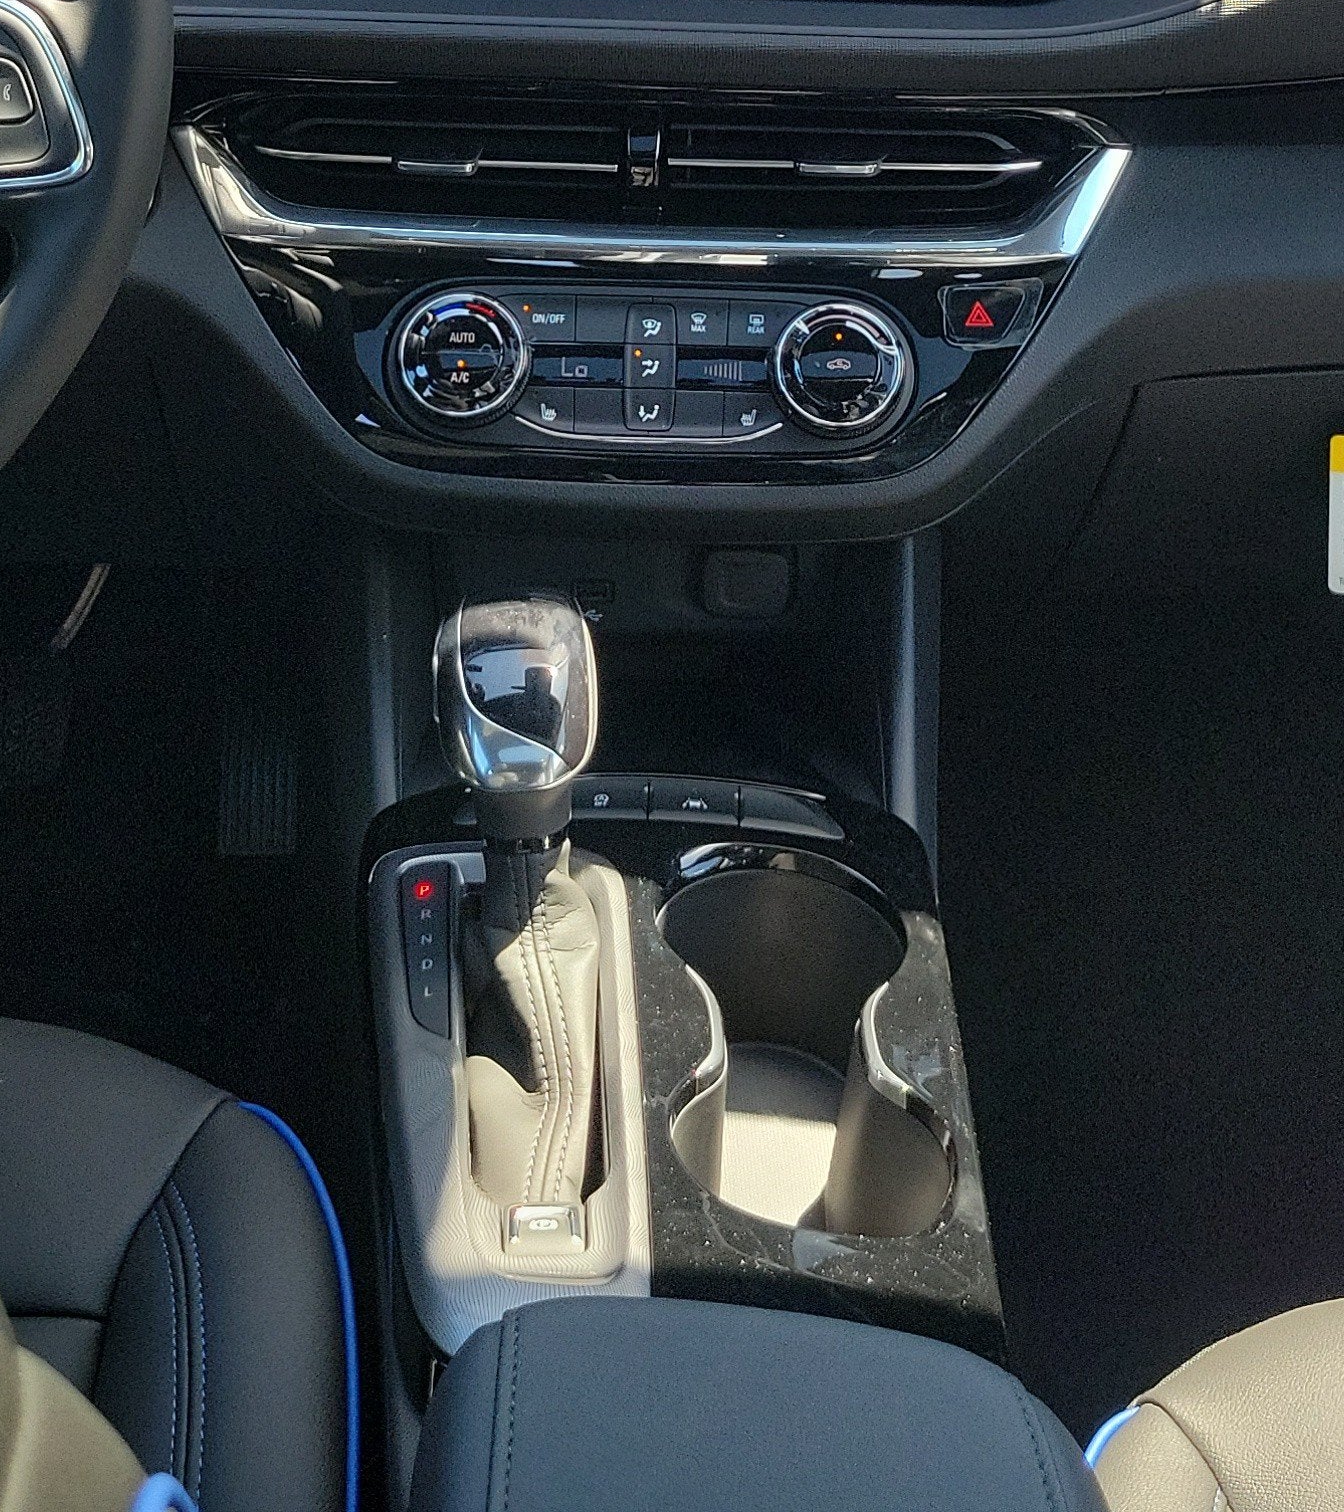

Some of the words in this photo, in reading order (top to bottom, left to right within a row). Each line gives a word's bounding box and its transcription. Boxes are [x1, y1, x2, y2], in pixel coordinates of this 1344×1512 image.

[532, 313, 566, 324] ON/OFF
[690, 322, 707, 333] MAX
[747, 325, 765, 335] REAR
[449, 332, 476, 343] AUTO
[450, 372, 470, 383] A/C
[419, 885, 430, 896] P
[420, 909, 431, 920] R
[421, 934, 433, 945] N
[422, 958, 433, 970] D
[424, 987, 433, 997] L
